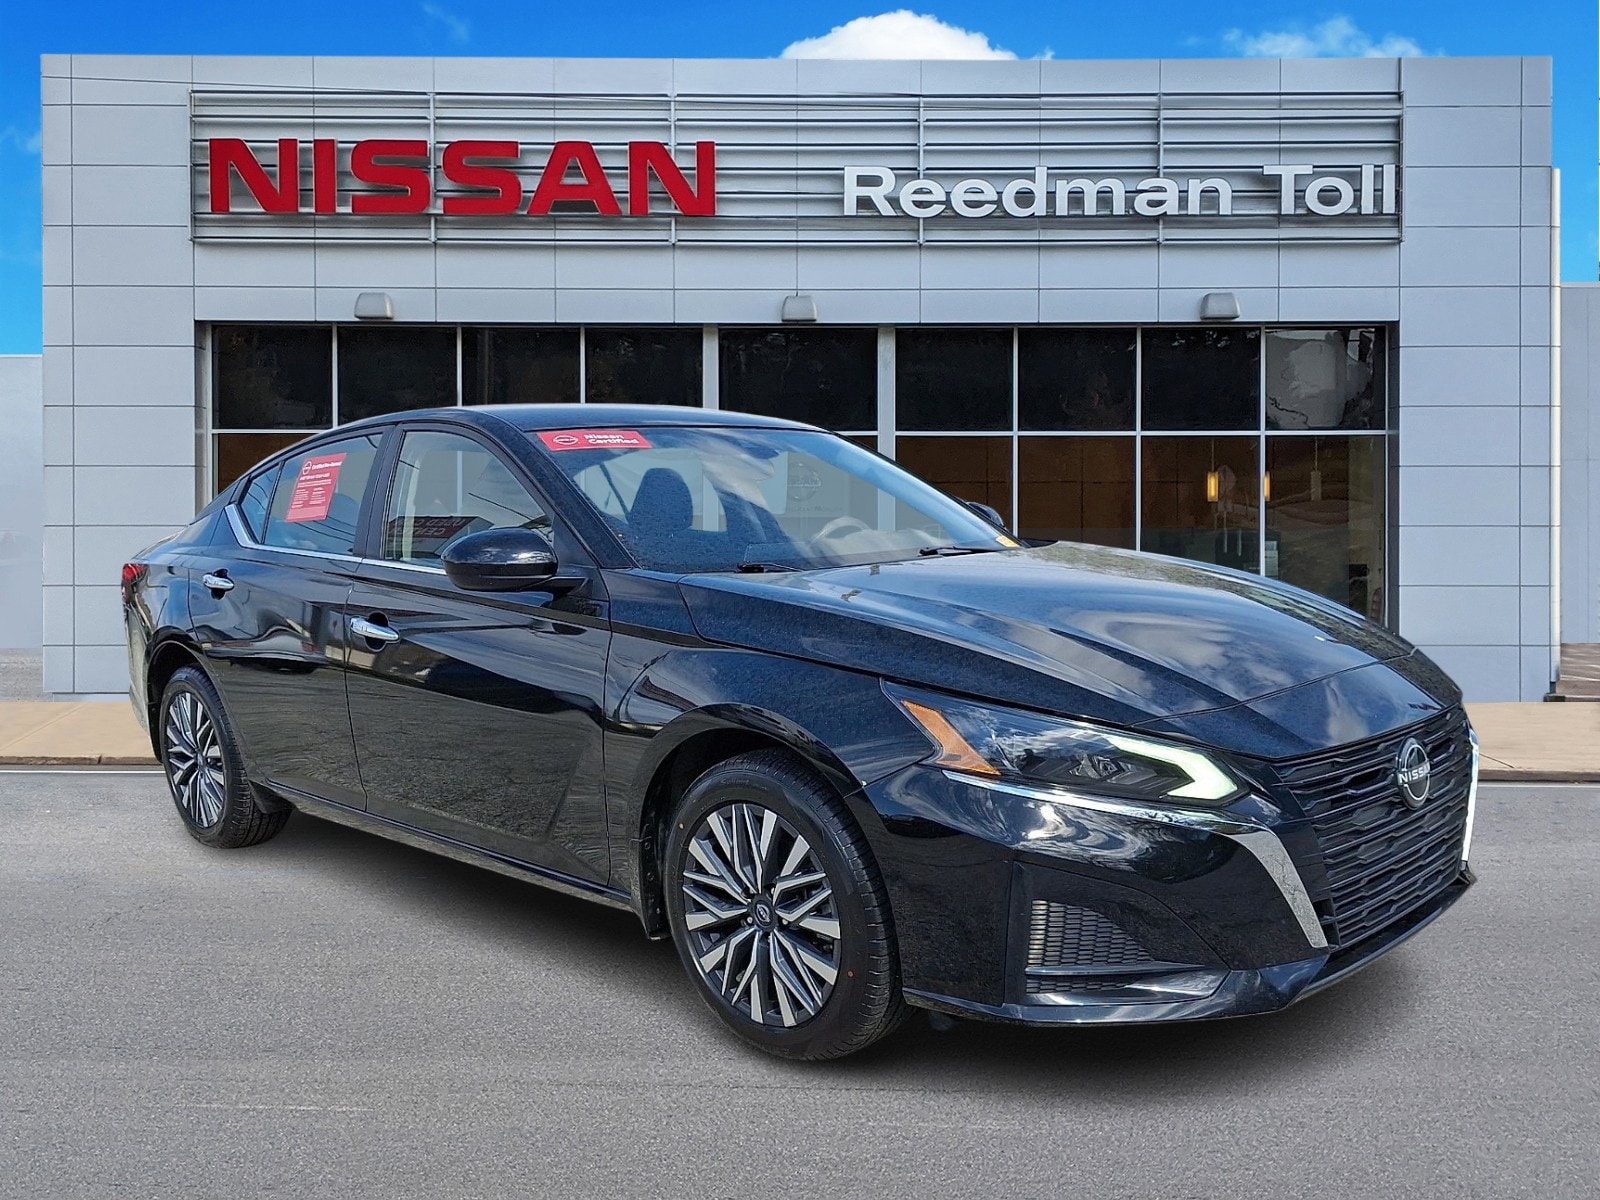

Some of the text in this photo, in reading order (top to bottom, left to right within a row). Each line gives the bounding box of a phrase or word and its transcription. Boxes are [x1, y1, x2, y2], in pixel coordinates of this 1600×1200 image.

[208, 138, 716, 216] NISSAN
[842, 164, 1397, 218] Reedman Toll
